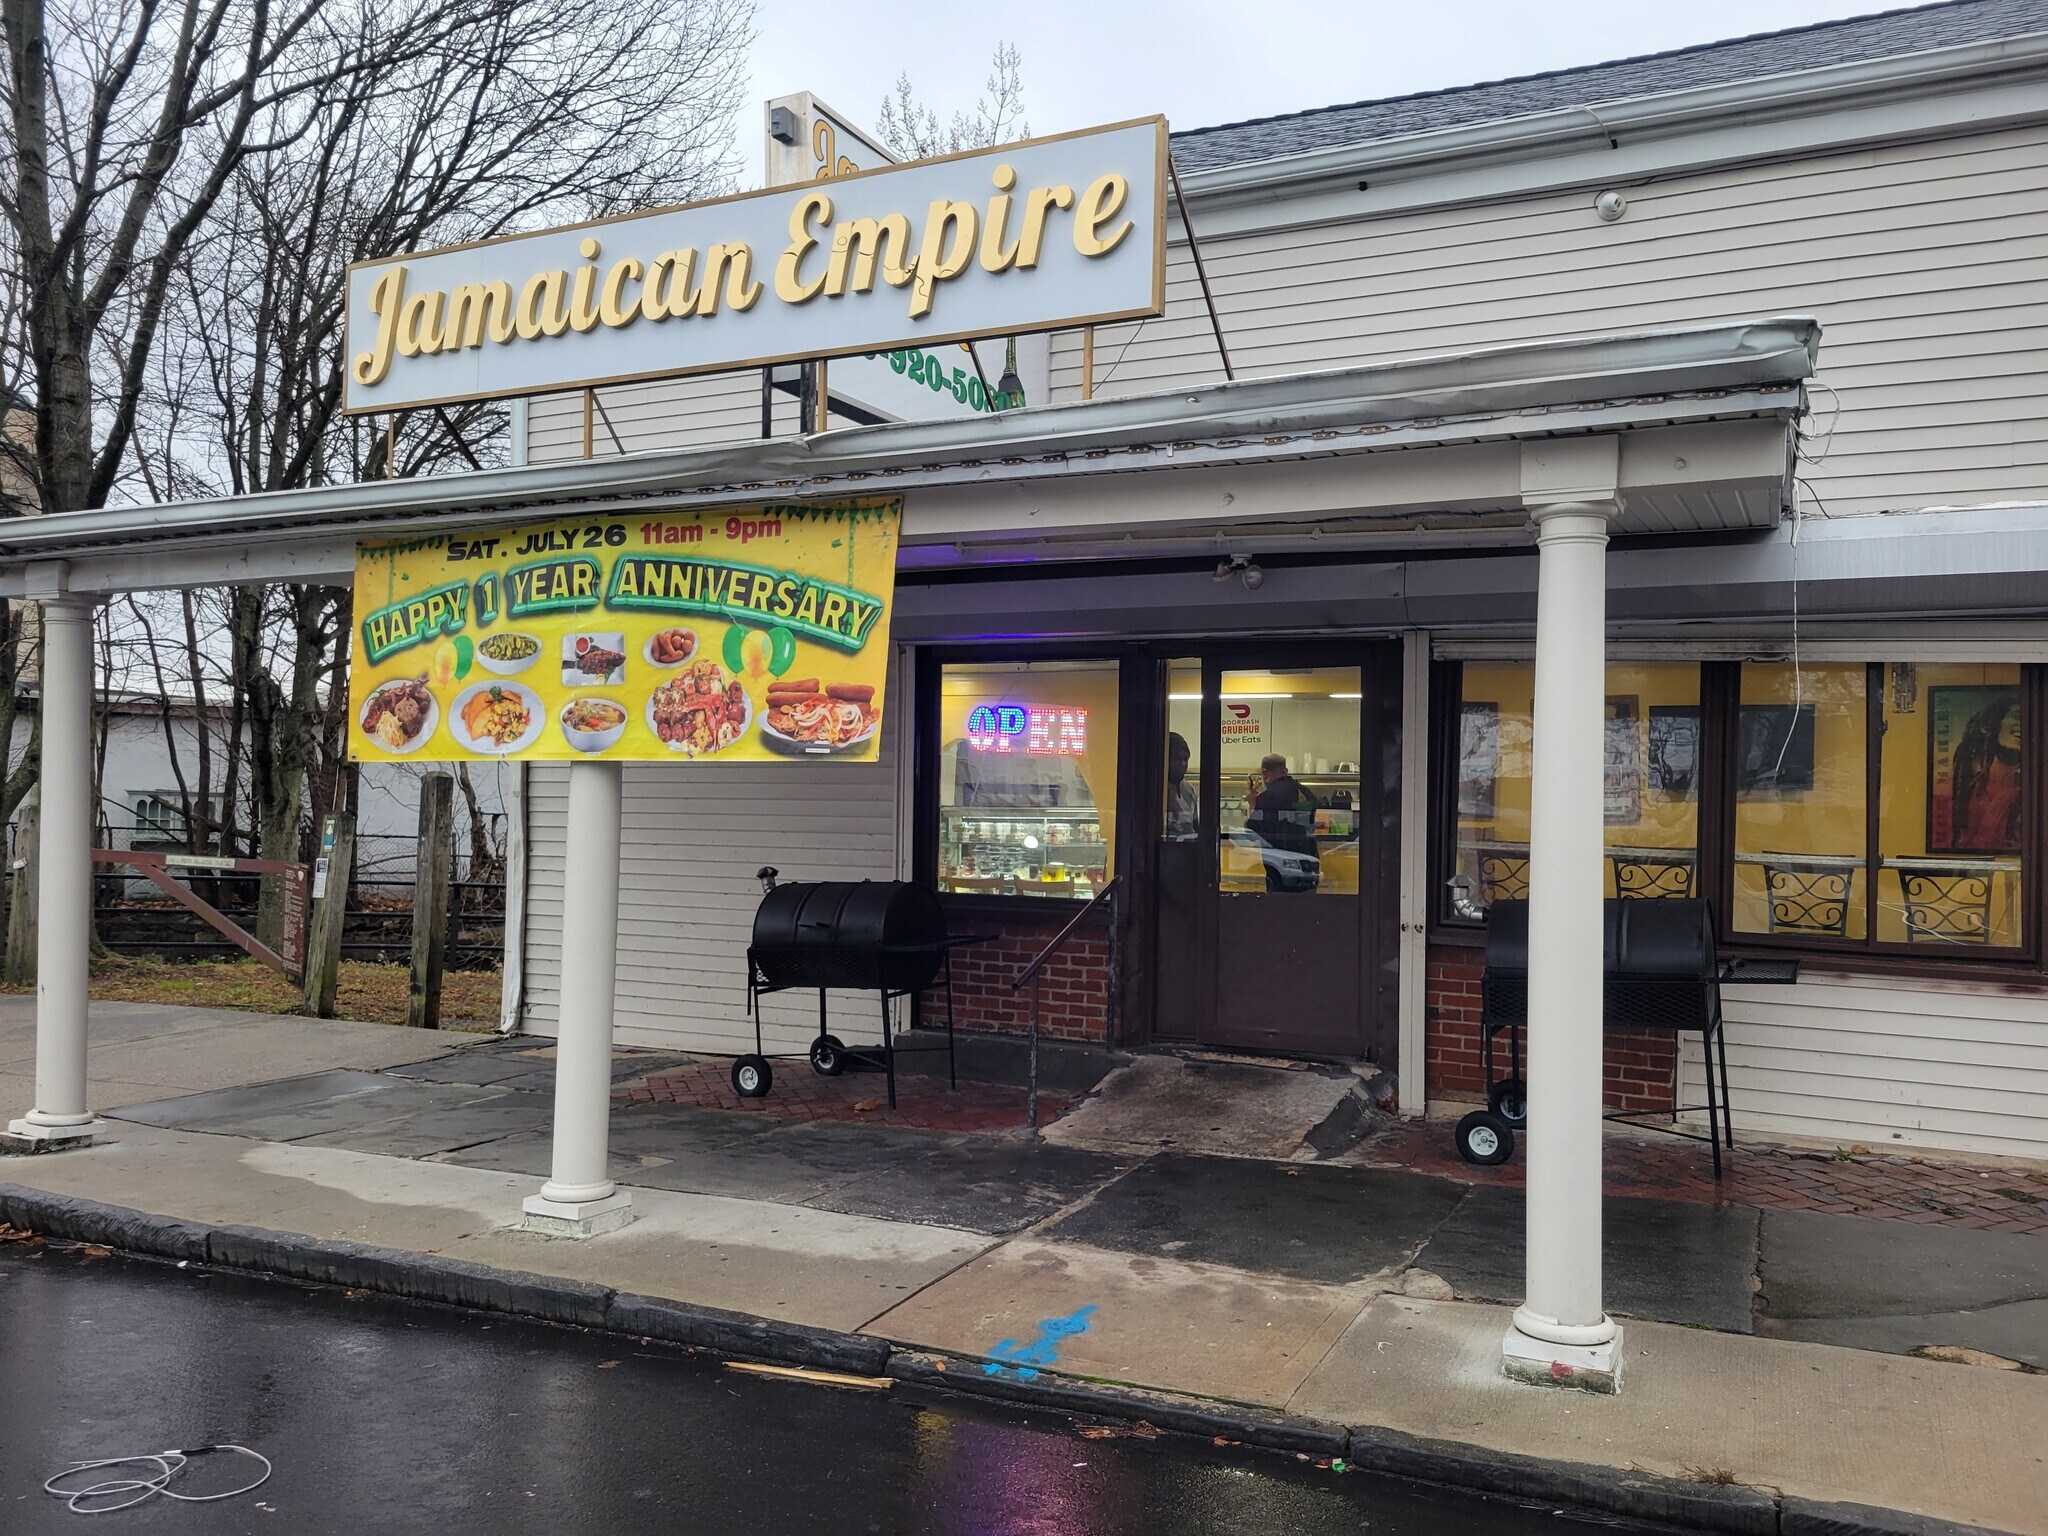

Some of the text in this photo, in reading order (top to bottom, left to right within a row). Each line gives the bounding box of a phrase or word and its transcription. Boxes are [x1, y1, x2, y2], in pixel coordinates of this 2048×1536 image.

[353, 164, 1135, 387] Jamaican Empire
[446, 538, 507, 562] SAT.
[640, 522, 703, 545] 11am
[726, 517, 782, 544] 9pm
[370, 562, 874, 652] HAPPY 1 YEAR ANNIVERSARY
[969, 706, 1087, 755] OPEN
[1222, 725, 1259, 734] GRUBHUB
[1222, 736, 1241, 744] Uber
